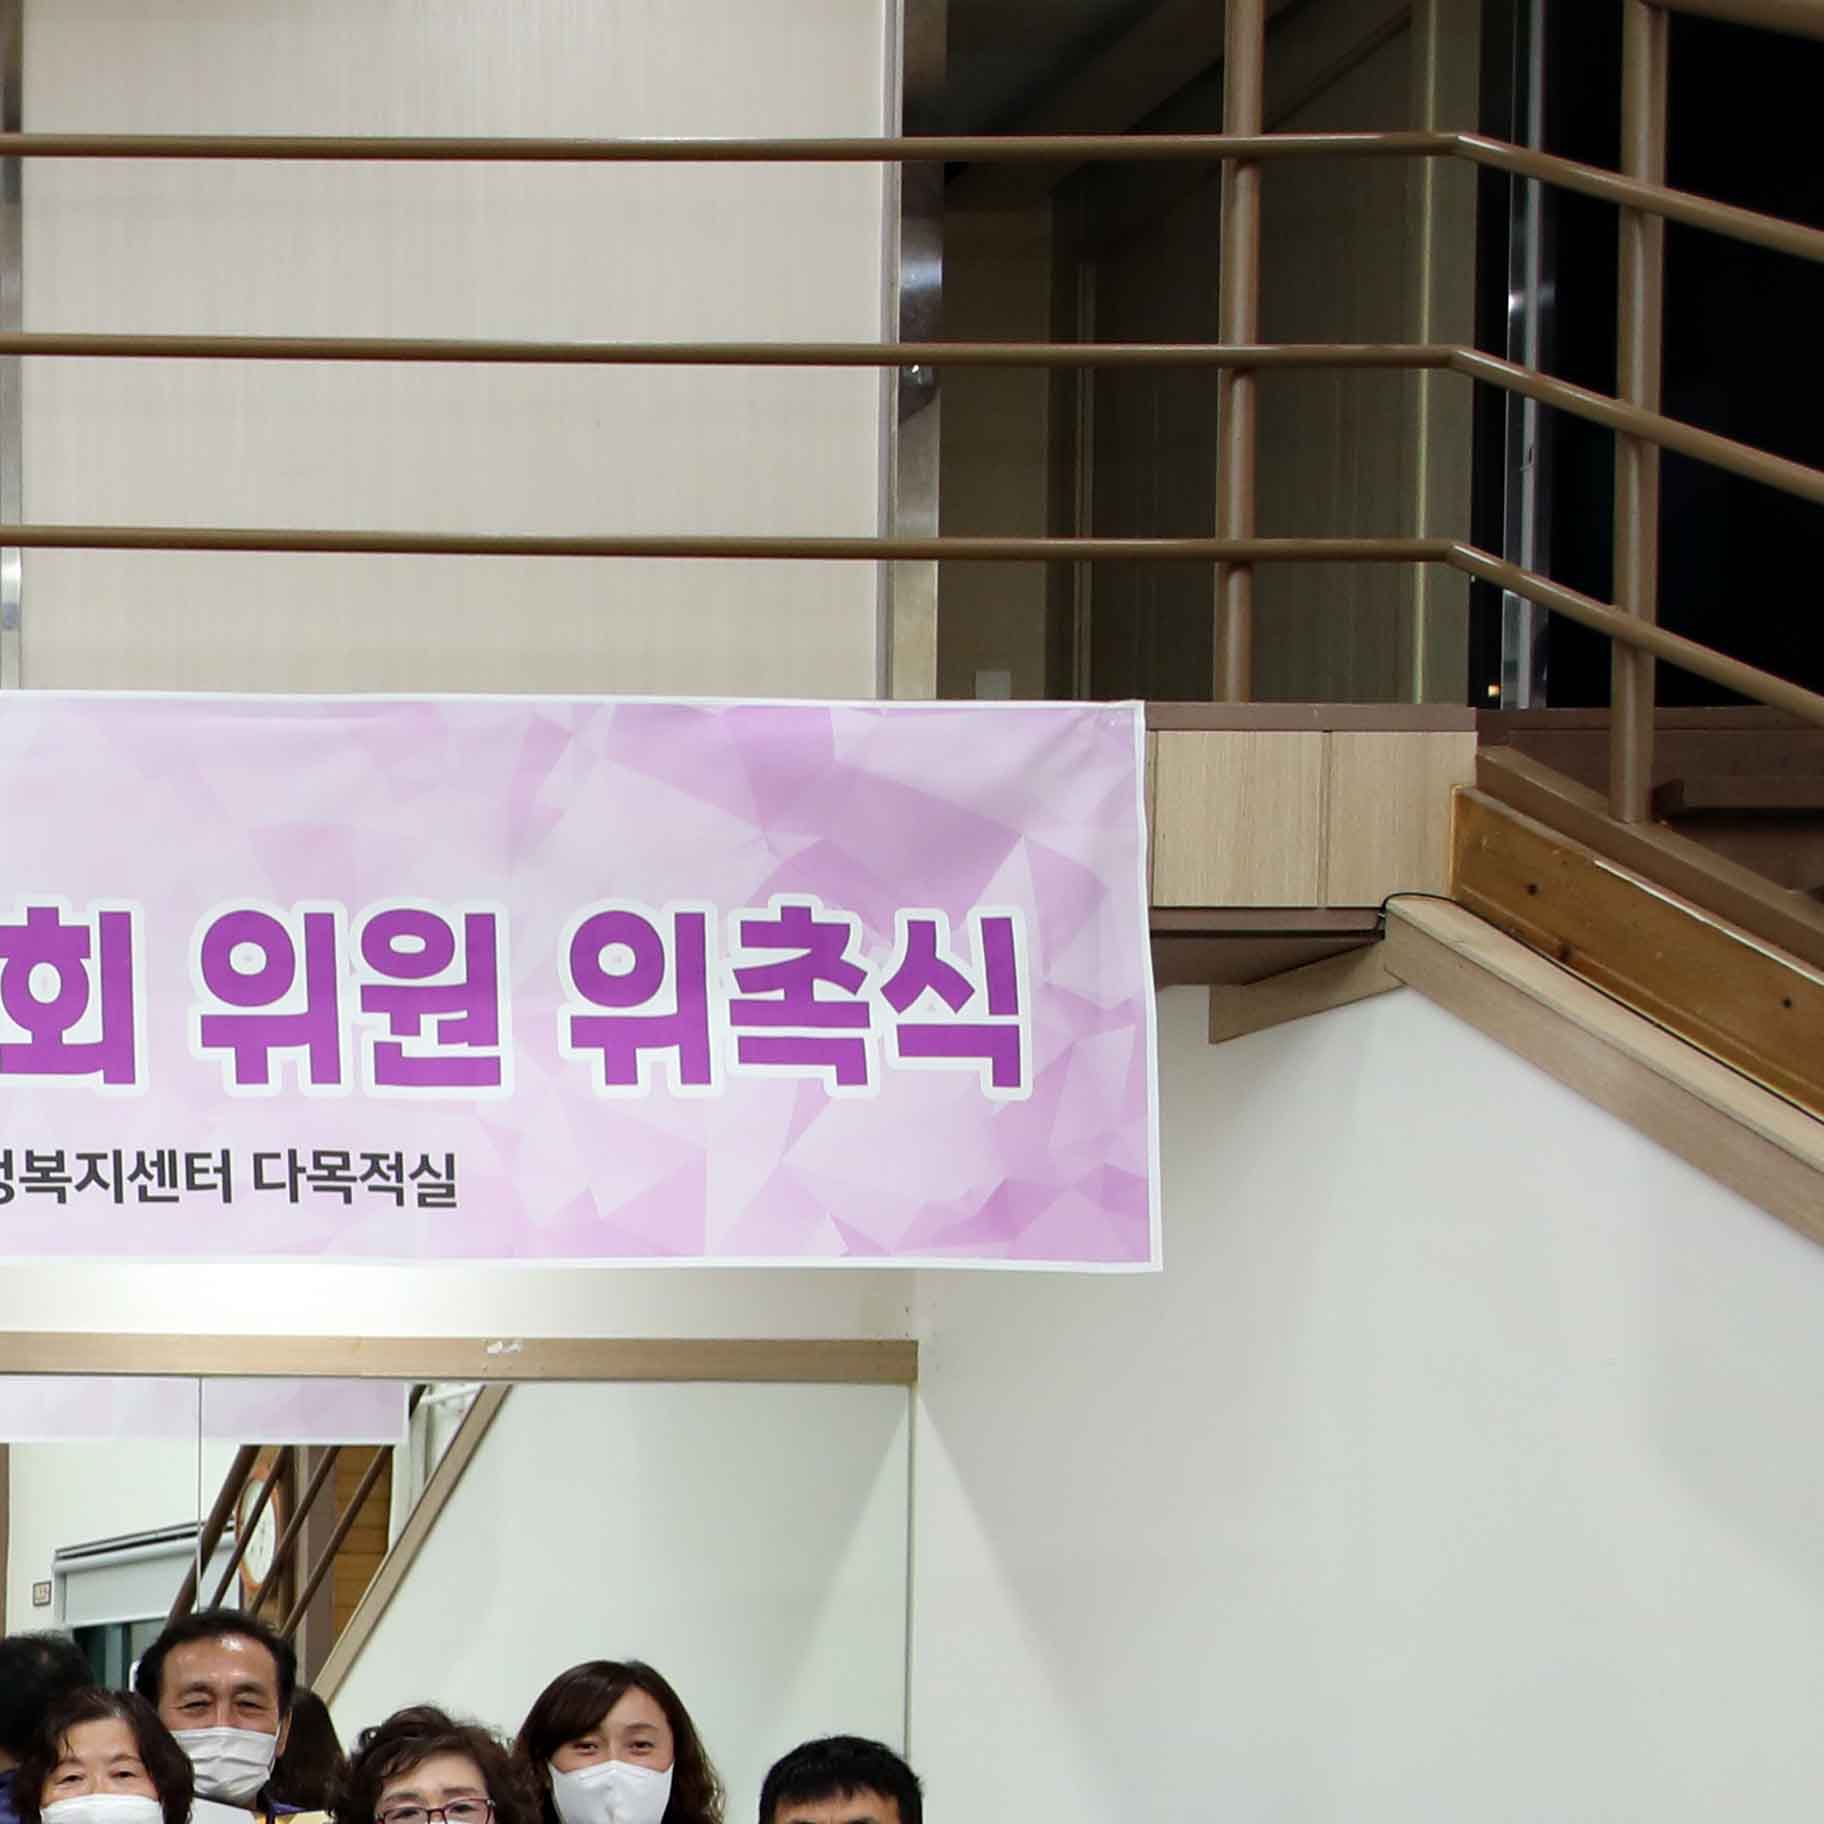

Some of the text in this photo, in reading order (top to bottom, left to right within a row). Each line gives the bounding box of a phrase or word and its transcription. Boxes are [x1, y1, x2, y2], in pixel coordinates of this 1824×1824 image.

[202, 911, 500, 1085] 위원
[571, 907, 1020, 1087] 위촉식
[253, 1148, 457, 1208] 다목적실
